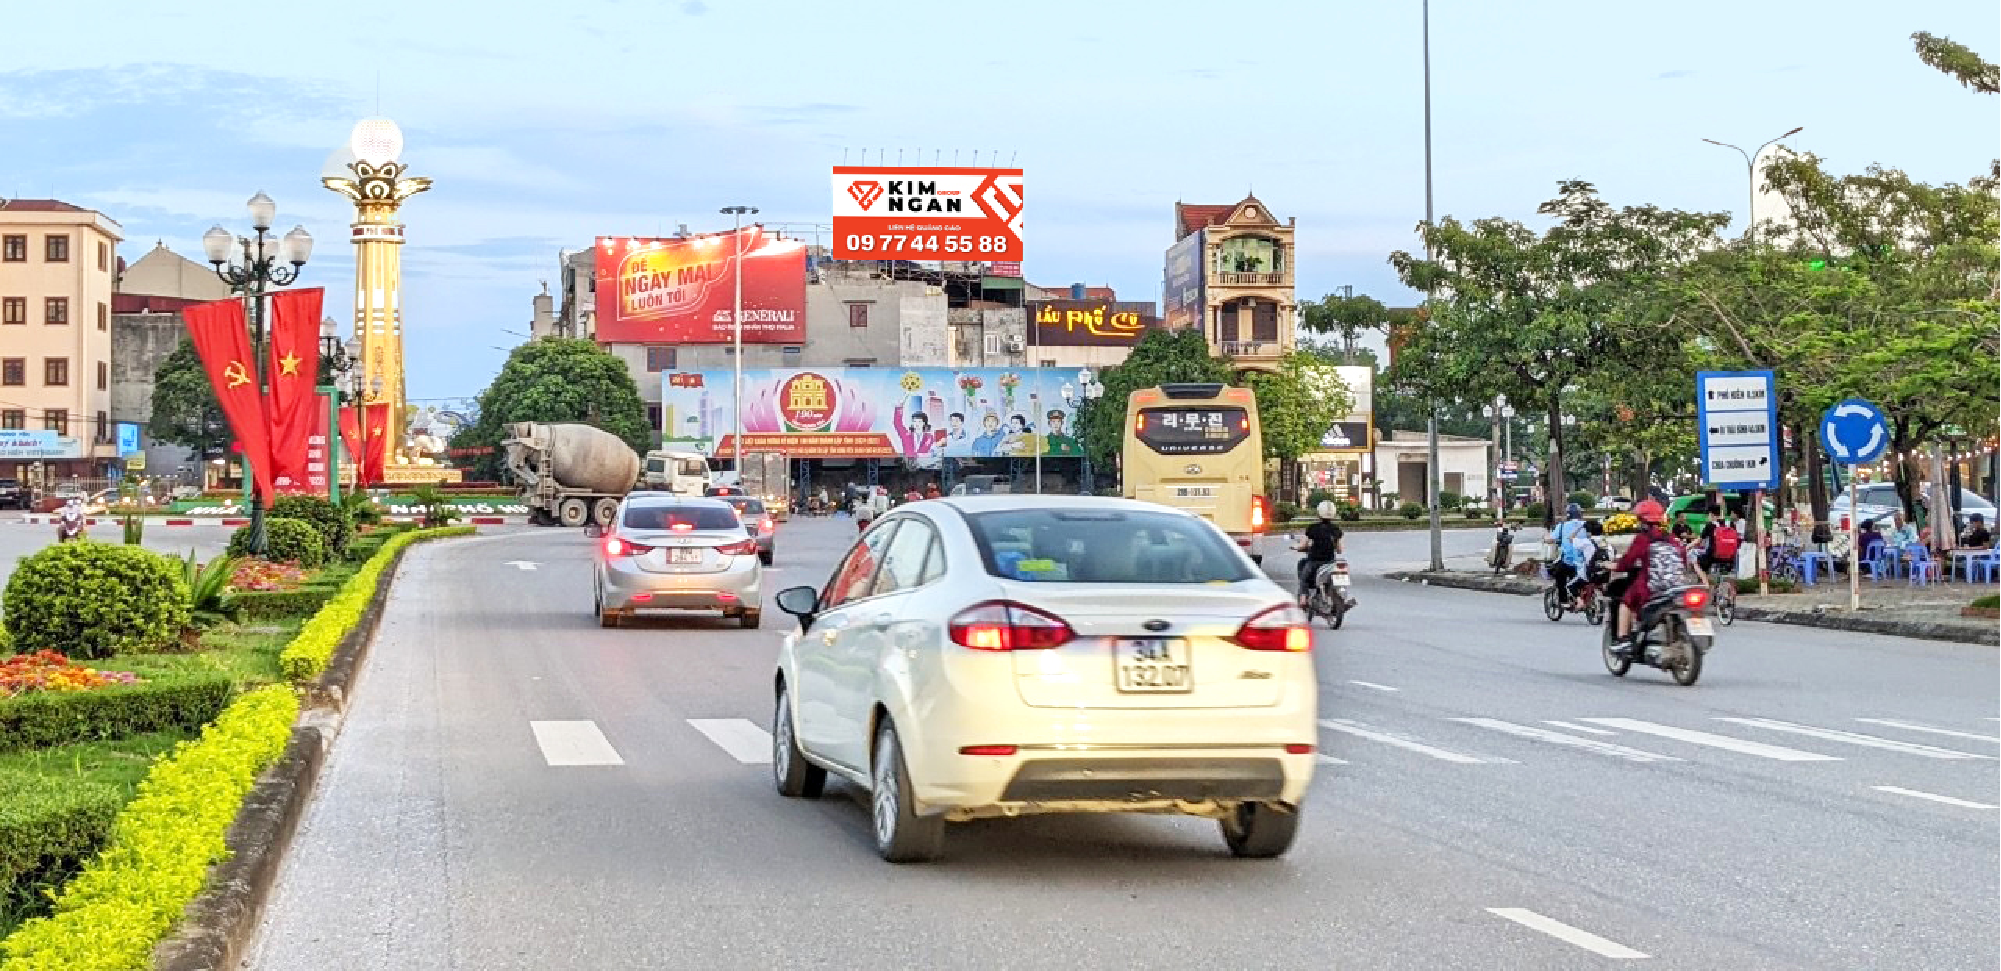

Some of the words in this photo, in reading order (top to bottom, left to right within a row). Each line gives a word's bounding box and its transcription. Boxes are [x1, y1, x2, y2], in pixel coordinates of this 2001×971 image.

[888, 180, 937, 195] KIM
[888, 197, 962, 212] NGAN
[846, 234, 875, 252] 09
[944, 235, 973, 253] 55
[978, 235, 1007, 254] 88
[625, 269, 672, 296] NGÀY
[678, 263, 713, 286] MAI
[631, 293, 663, 311] LUÔN
